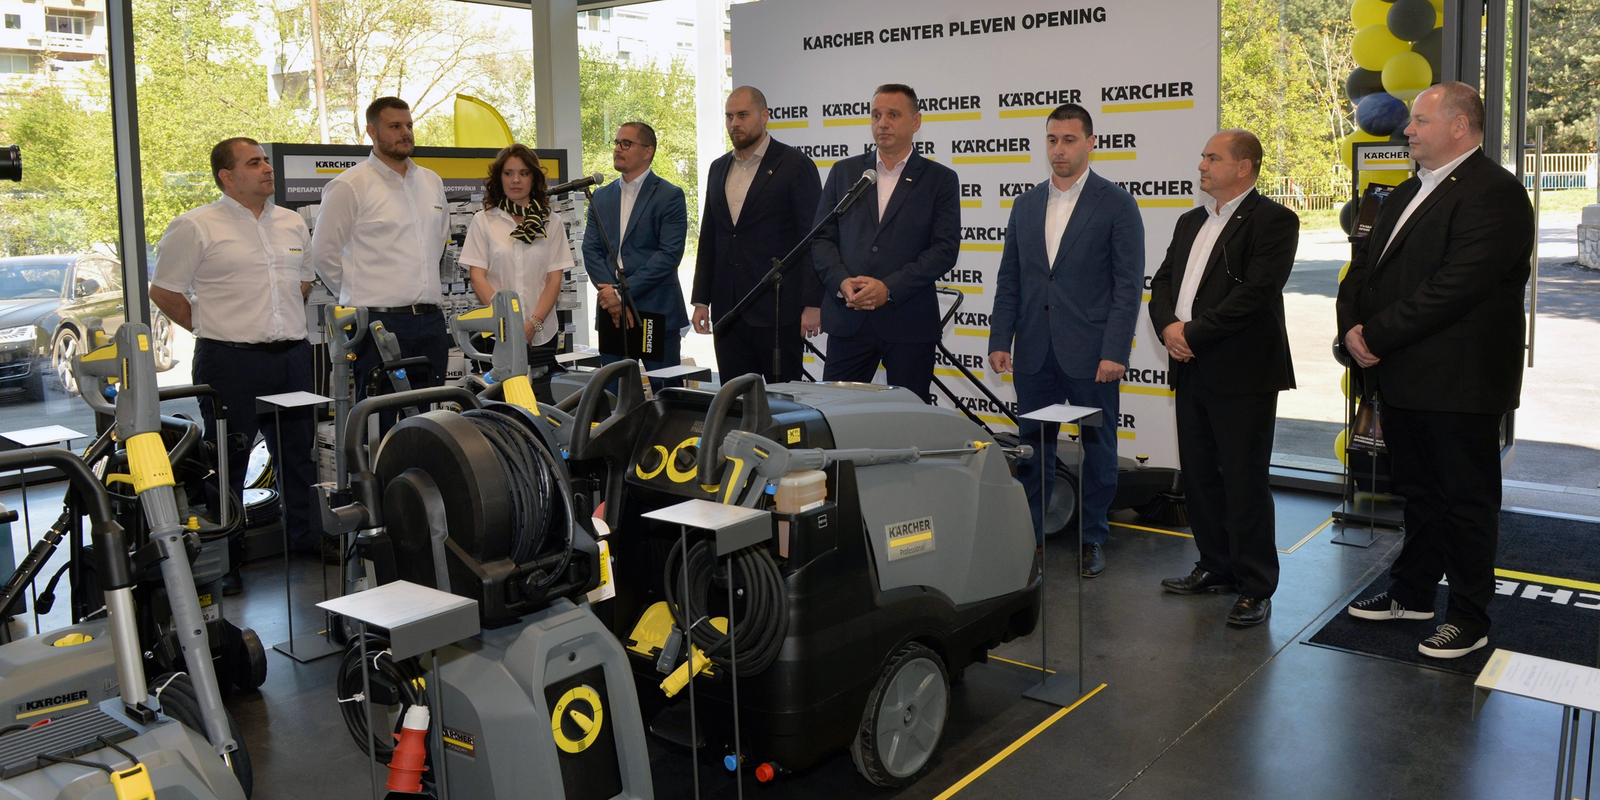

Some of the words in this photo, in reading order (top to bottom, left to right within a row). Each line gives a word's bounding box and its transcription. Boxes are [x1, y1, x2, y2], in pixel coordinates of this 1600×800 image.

[803, 31, 874, 50] KARCHER
[879, 23, 943, 43] CENTER
[949, 16, 1015, 36] PLEVEN
[1022, 6, 1106, 29] OPENING
[999, 89, 1081, 107] KÄRCHER
[1101, 81, 1193, 101] KÄRCHER
[822, 101, 871, 116] KÄRCH
[917, 95, 981, 111] ÄRCHER
[767, 106, 808, 119] RCHER
[794, 144, 849, 157] RCHER
[952, 138, 1030, 153] KÄRCHER
[1114, 180, 1193, 195] RCHER
[960, 227, 1008, 241] ÄRCH
[938, 270, 983, 283] CHER
[889, 519, 931, 538] KÄRCHER
[26, 690, 88, 711] KÄRCHER
